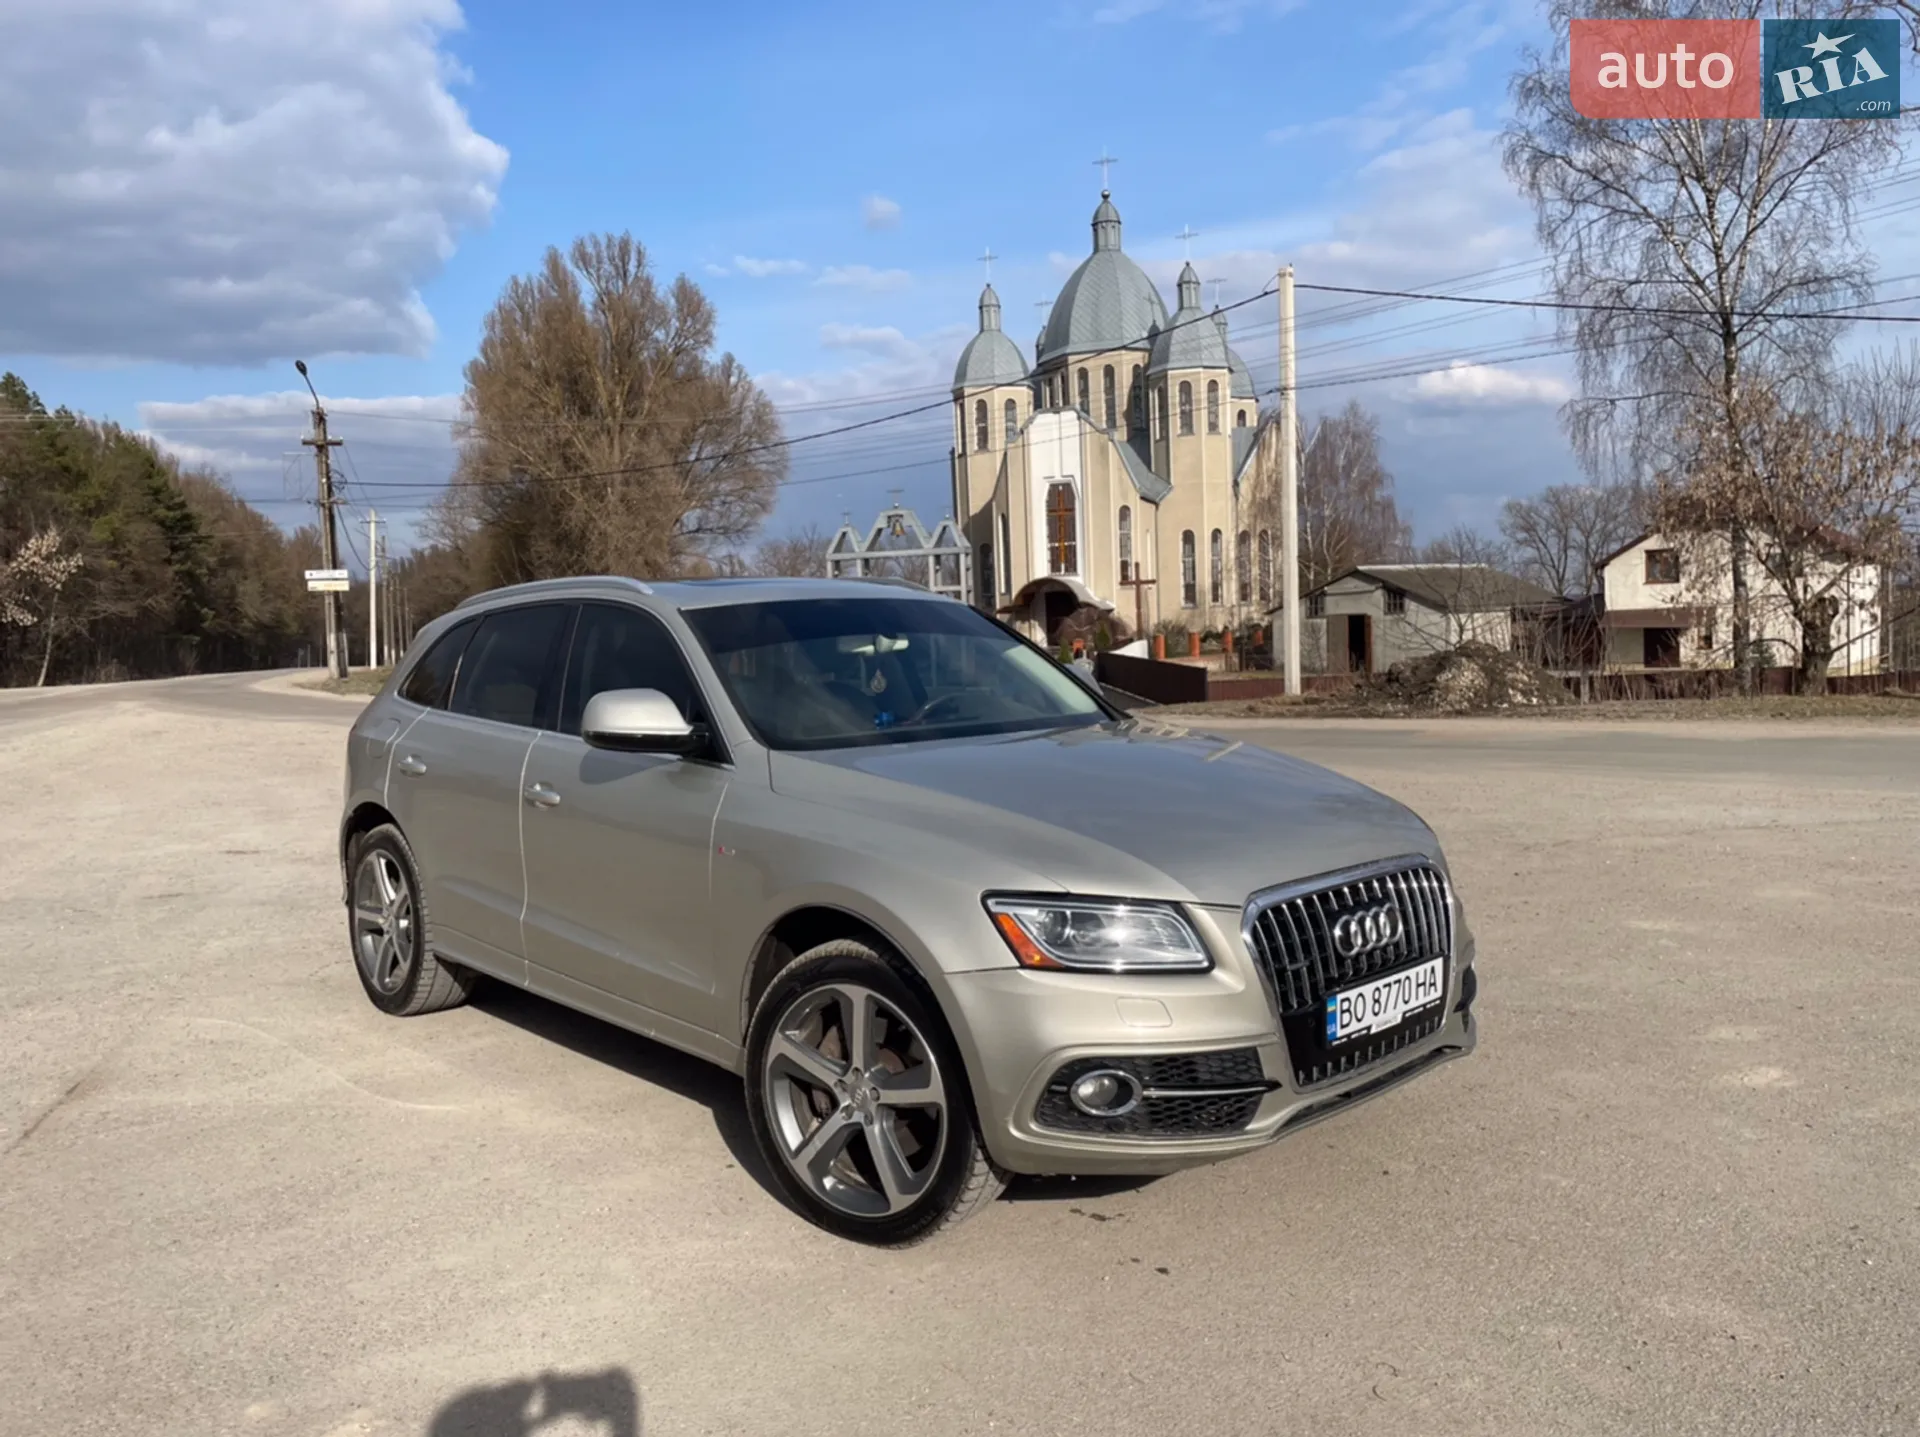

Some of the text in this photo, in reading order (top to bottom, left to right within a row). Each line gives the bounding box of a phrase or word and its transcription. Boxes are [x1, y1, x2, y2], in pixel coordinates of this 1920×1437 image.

[1340, 993, 1367, 1029] BO
[1372, 976, 1412, 1016] 8770
[1415, 966, 1438, 1000] HA
